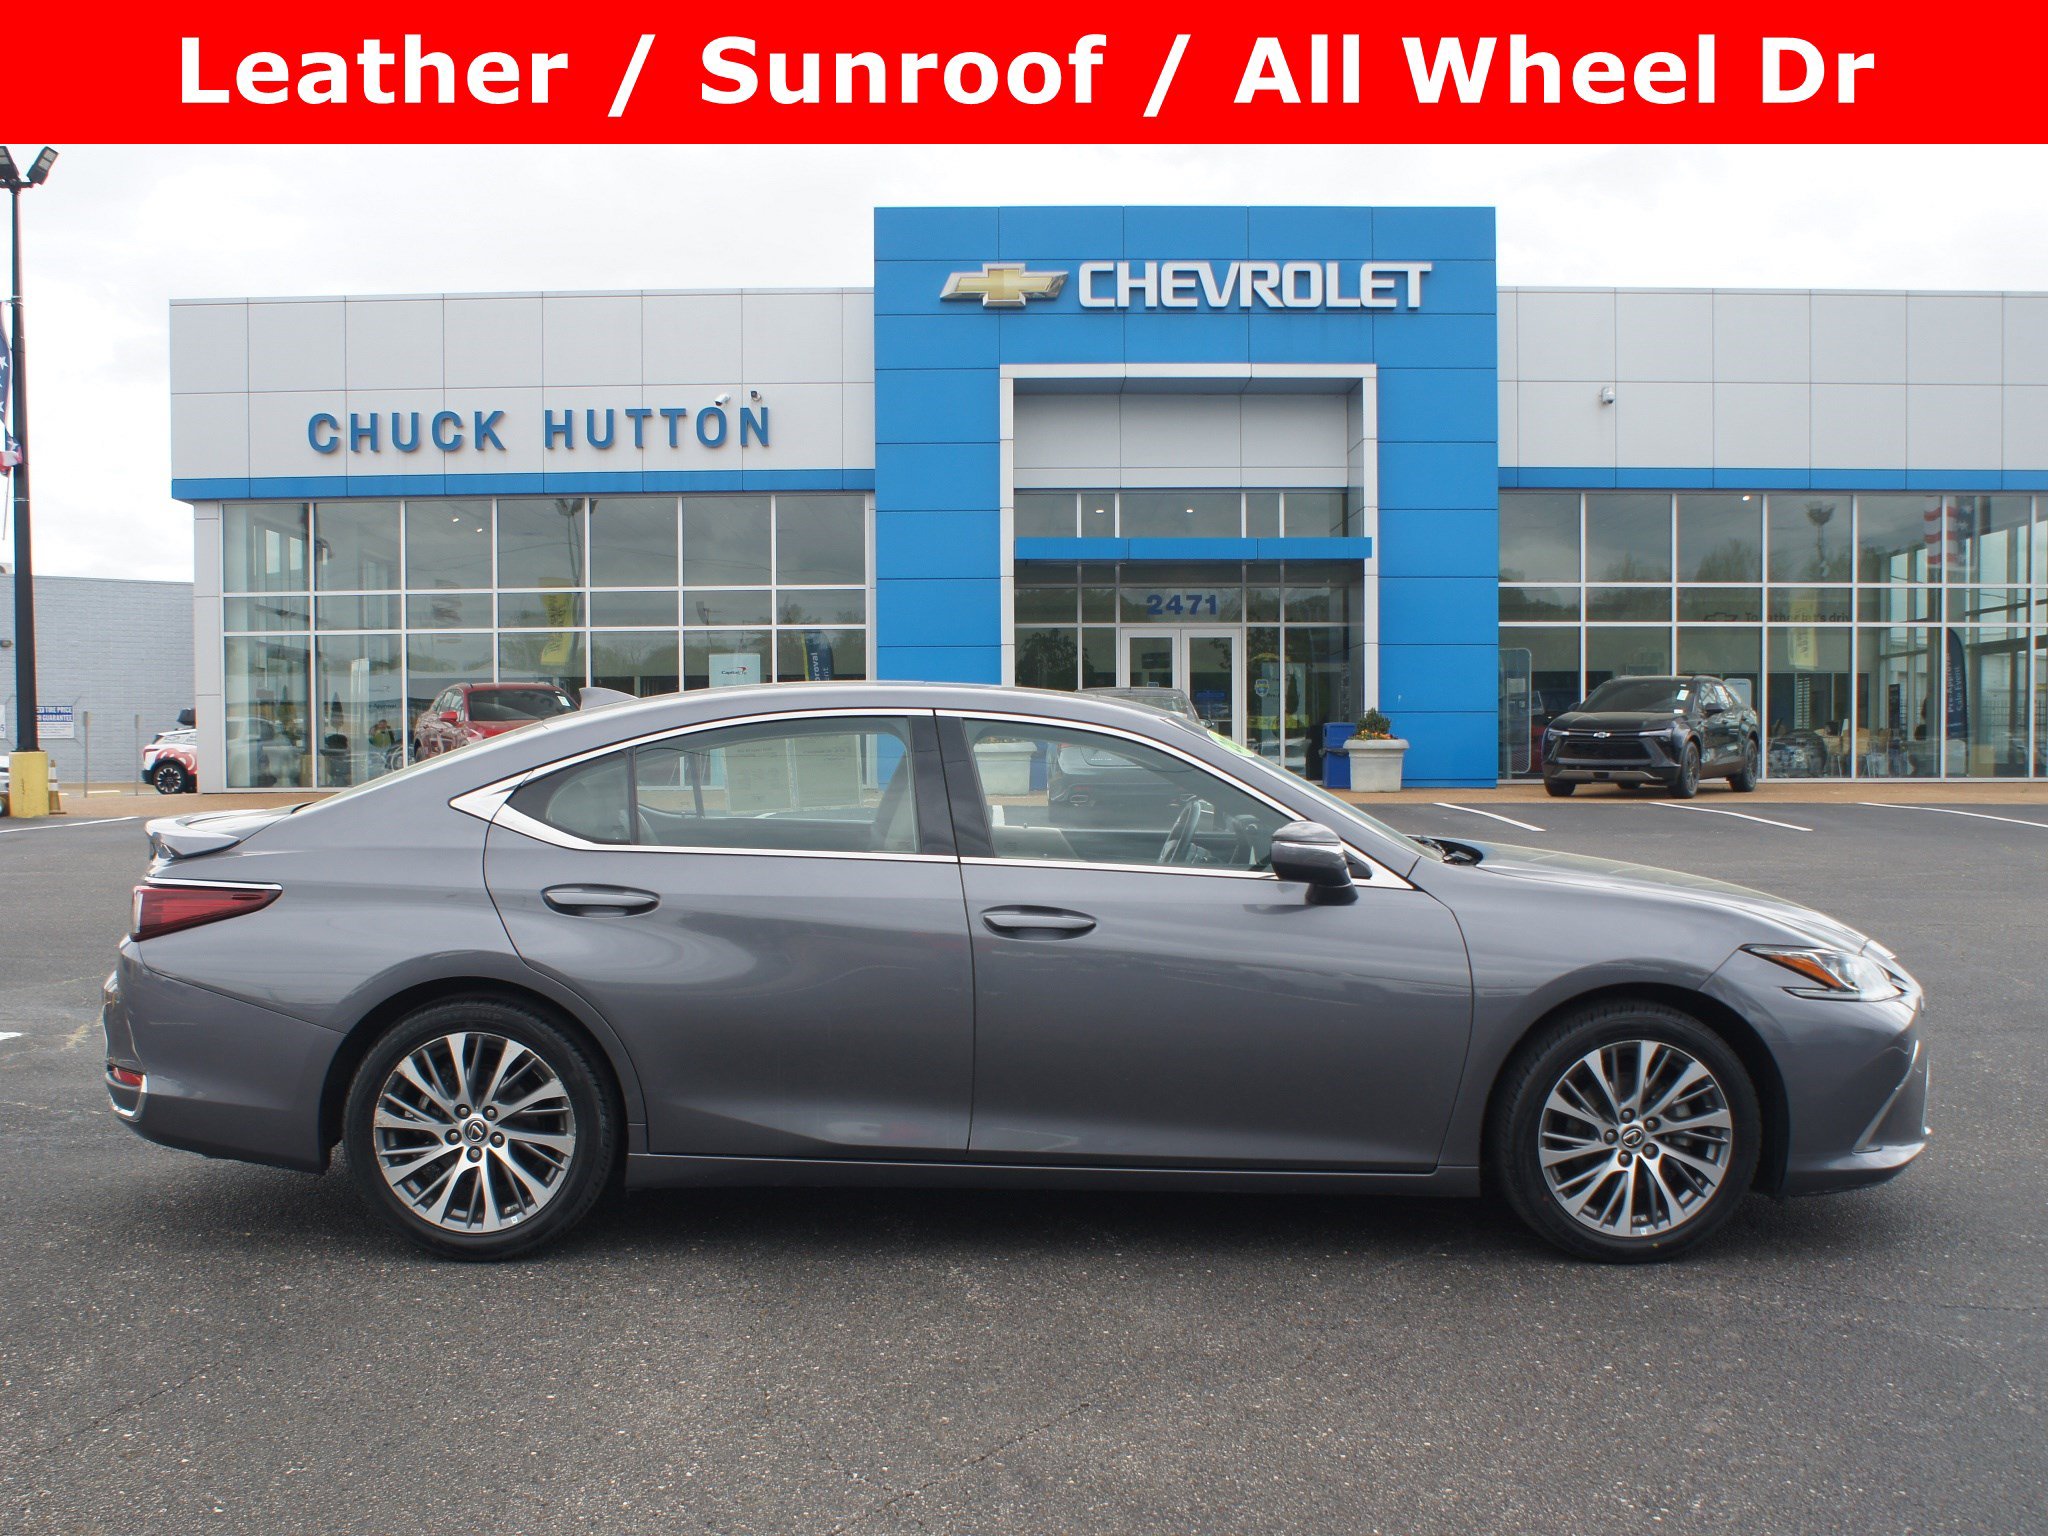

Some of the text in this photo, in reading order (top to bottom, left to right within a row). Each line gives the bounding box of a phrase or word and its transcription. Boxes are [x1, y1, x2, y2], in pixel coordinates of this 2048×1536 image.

[1079, 261, 1432, 308] CHEVROLET
[308, 407, 769, 454] CHUCK HUTTON
[1147, 594, 1217, 615] 2471
